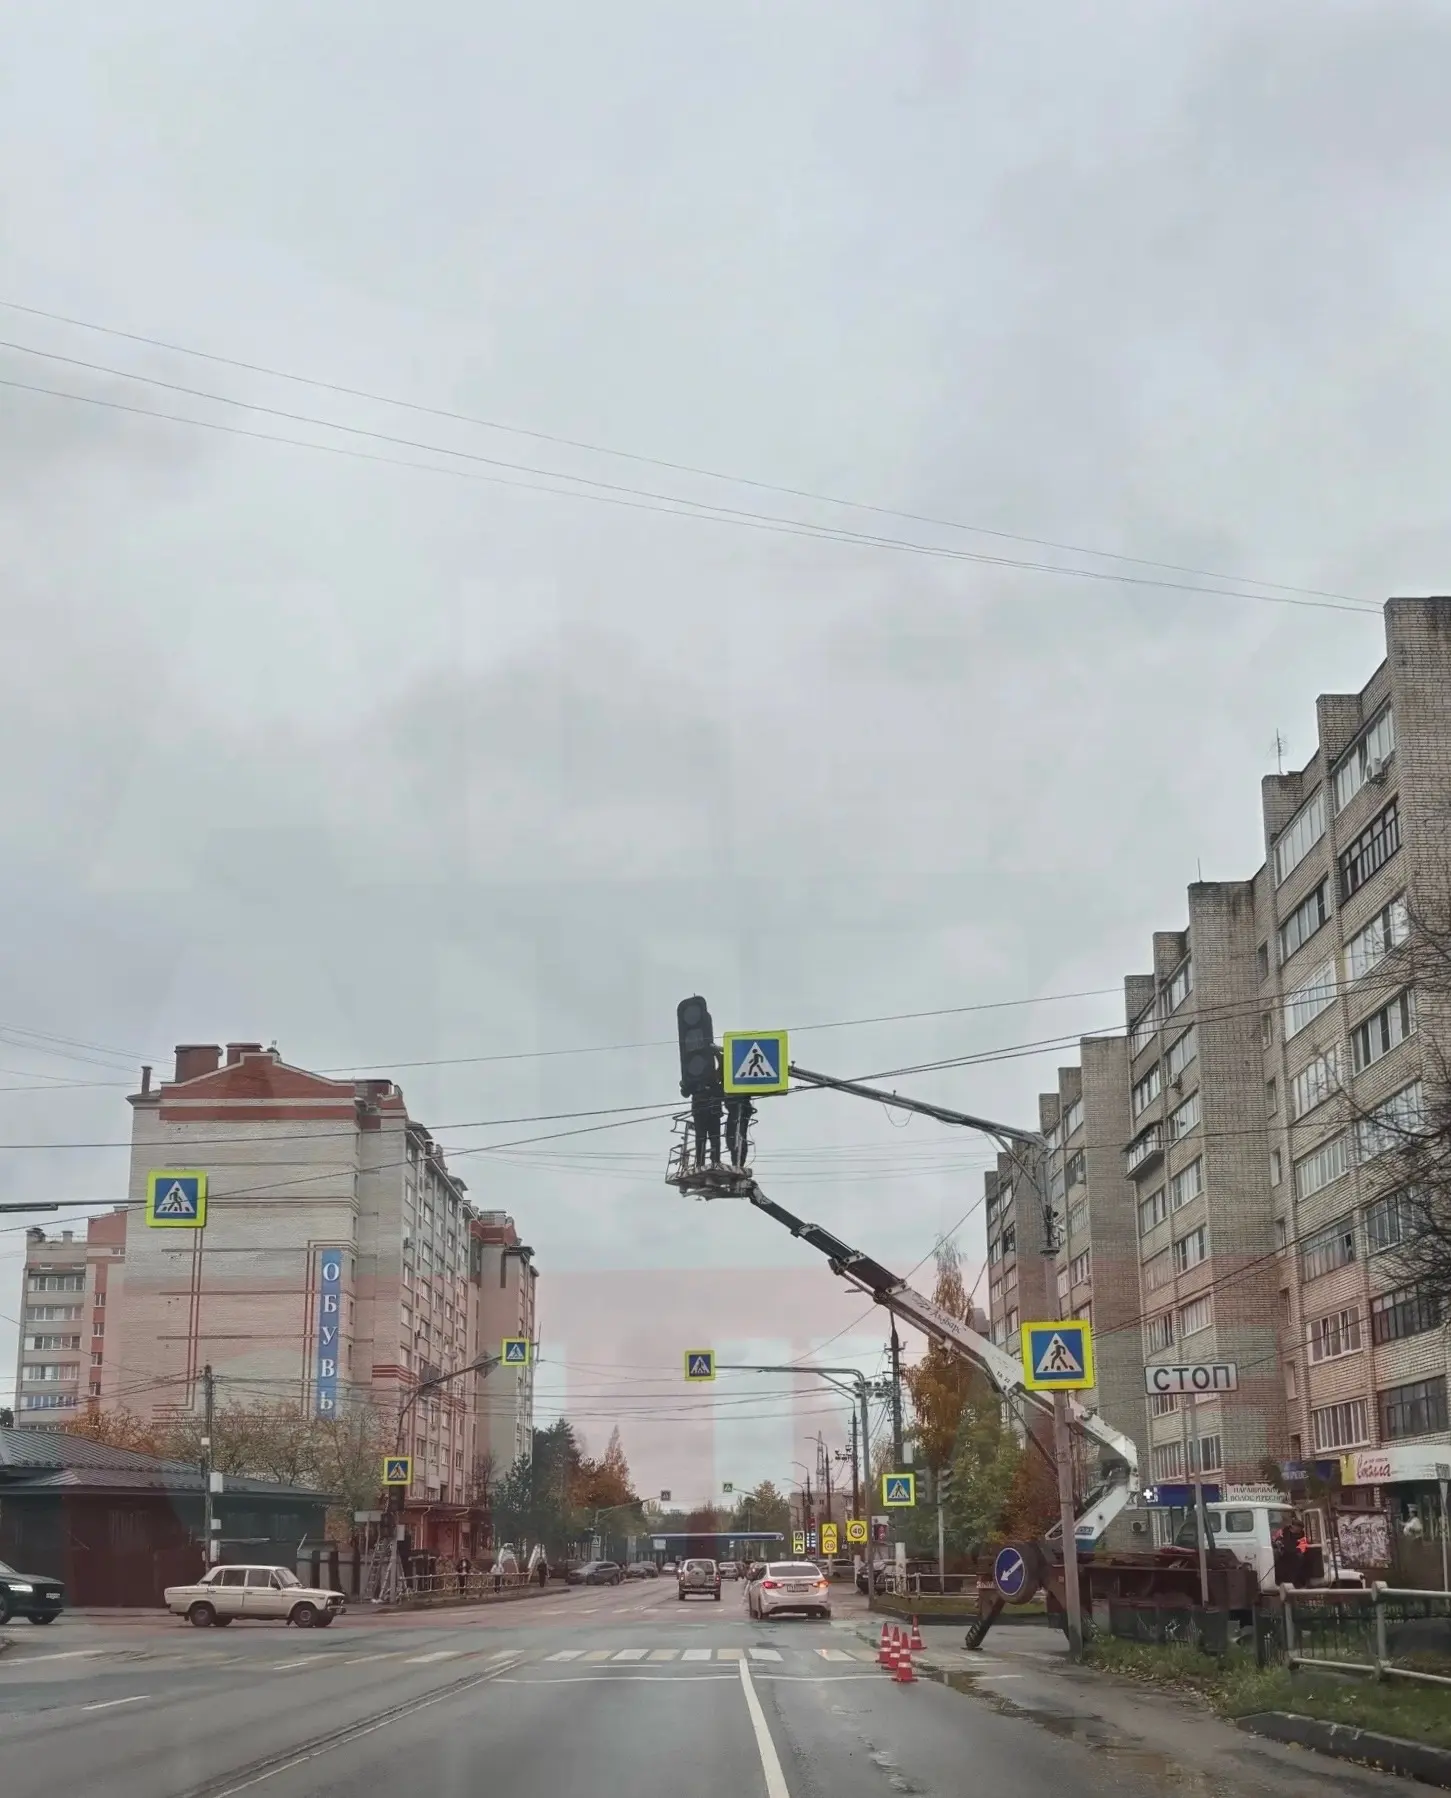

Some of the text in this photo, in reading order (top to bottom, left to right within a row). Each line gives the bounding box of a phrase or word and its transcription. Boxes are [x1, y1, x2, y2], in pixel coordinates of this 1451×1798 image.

[320, 1262, 340, 1410] ОБУВЬ
[1153, 1365, 1231, 1391] СТОП
[852, 1527, 862, 1535] 40
